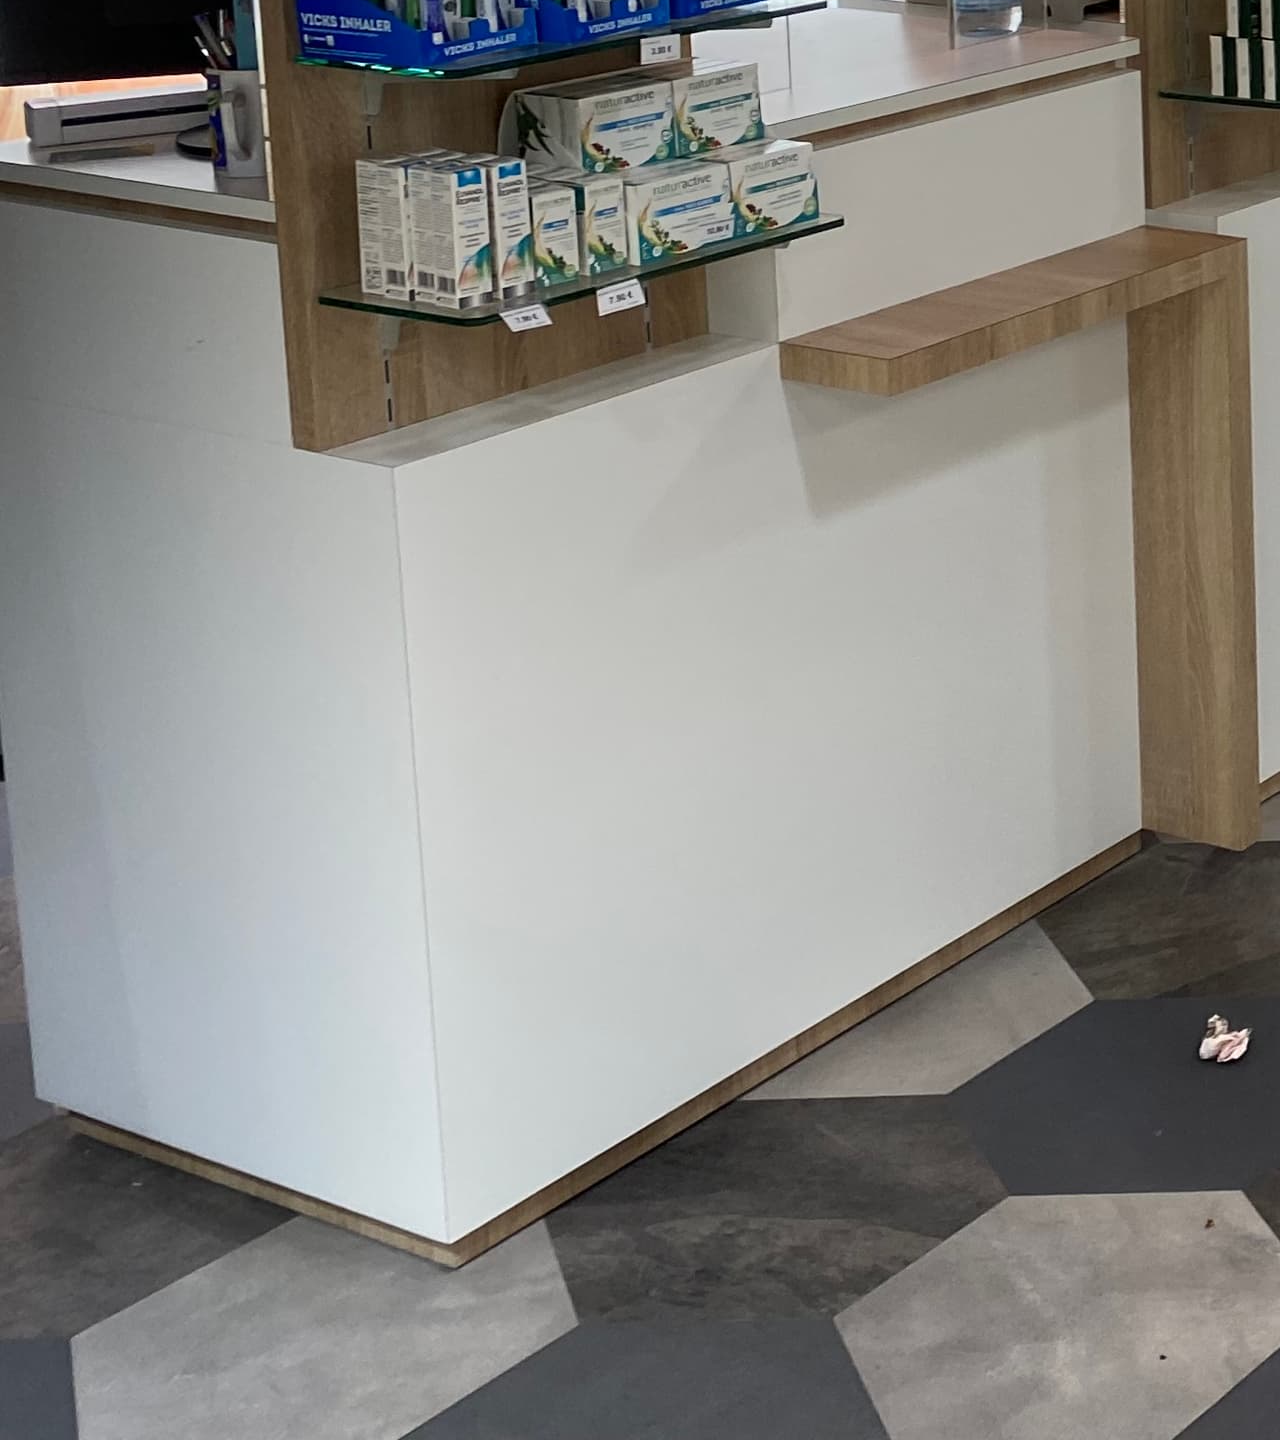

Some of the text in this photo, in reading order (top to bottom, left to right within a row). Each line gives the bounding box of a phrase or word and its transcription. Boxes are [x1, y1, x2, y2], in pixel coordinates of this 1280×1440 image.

[301, 13, 392, 33] VICKS INHALER
[443, 32, 517, 57] VICKS INHALER
[594, 90, 655, 110] naturactive
[652, 173, 713, 195] naturactive
